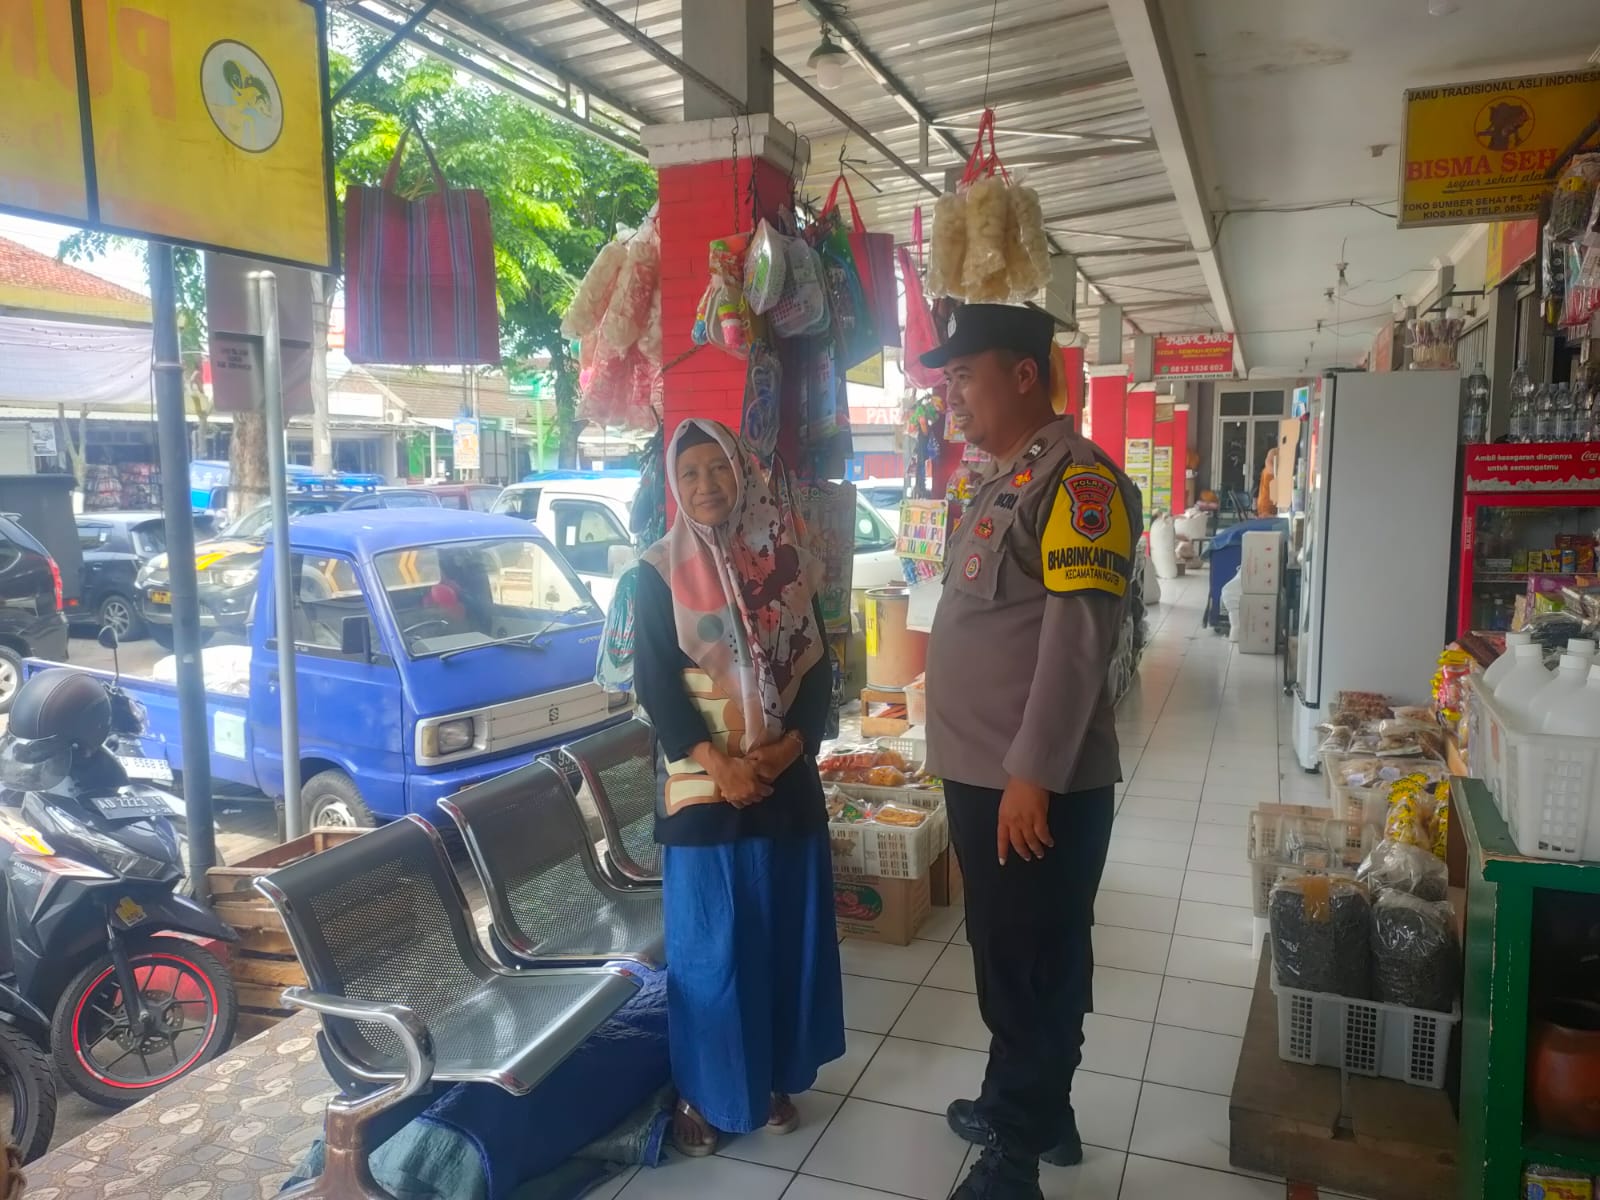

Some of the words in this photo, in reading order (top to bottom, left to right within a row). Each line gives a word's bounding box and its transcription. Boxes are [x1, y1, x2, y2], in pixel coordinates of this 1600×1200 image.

[1408, 90, 1438, 101] JAMU
[1442, 81, 1515, 98] TRADISIONAL
[1518, 77, 1543, 90] ASLI
[1545, 71, 1600, 87] INDONES
[1406, 154, 1492, 181] BISMA
[1485, 172, 1517, 185] sehat
[1404, 202, 1430, 211] TOKO
[1432, 198, 1473, 209] SUMBER
[1475, 195, 1507, 206] SEHAT
[1424, 210, 1447, 219] KIOS
[1475, 454, 1496, 462] Ambil
[1536, 453, 1573, 463] dinginnya
[1510, 464, 1559, 473] semangatmu
